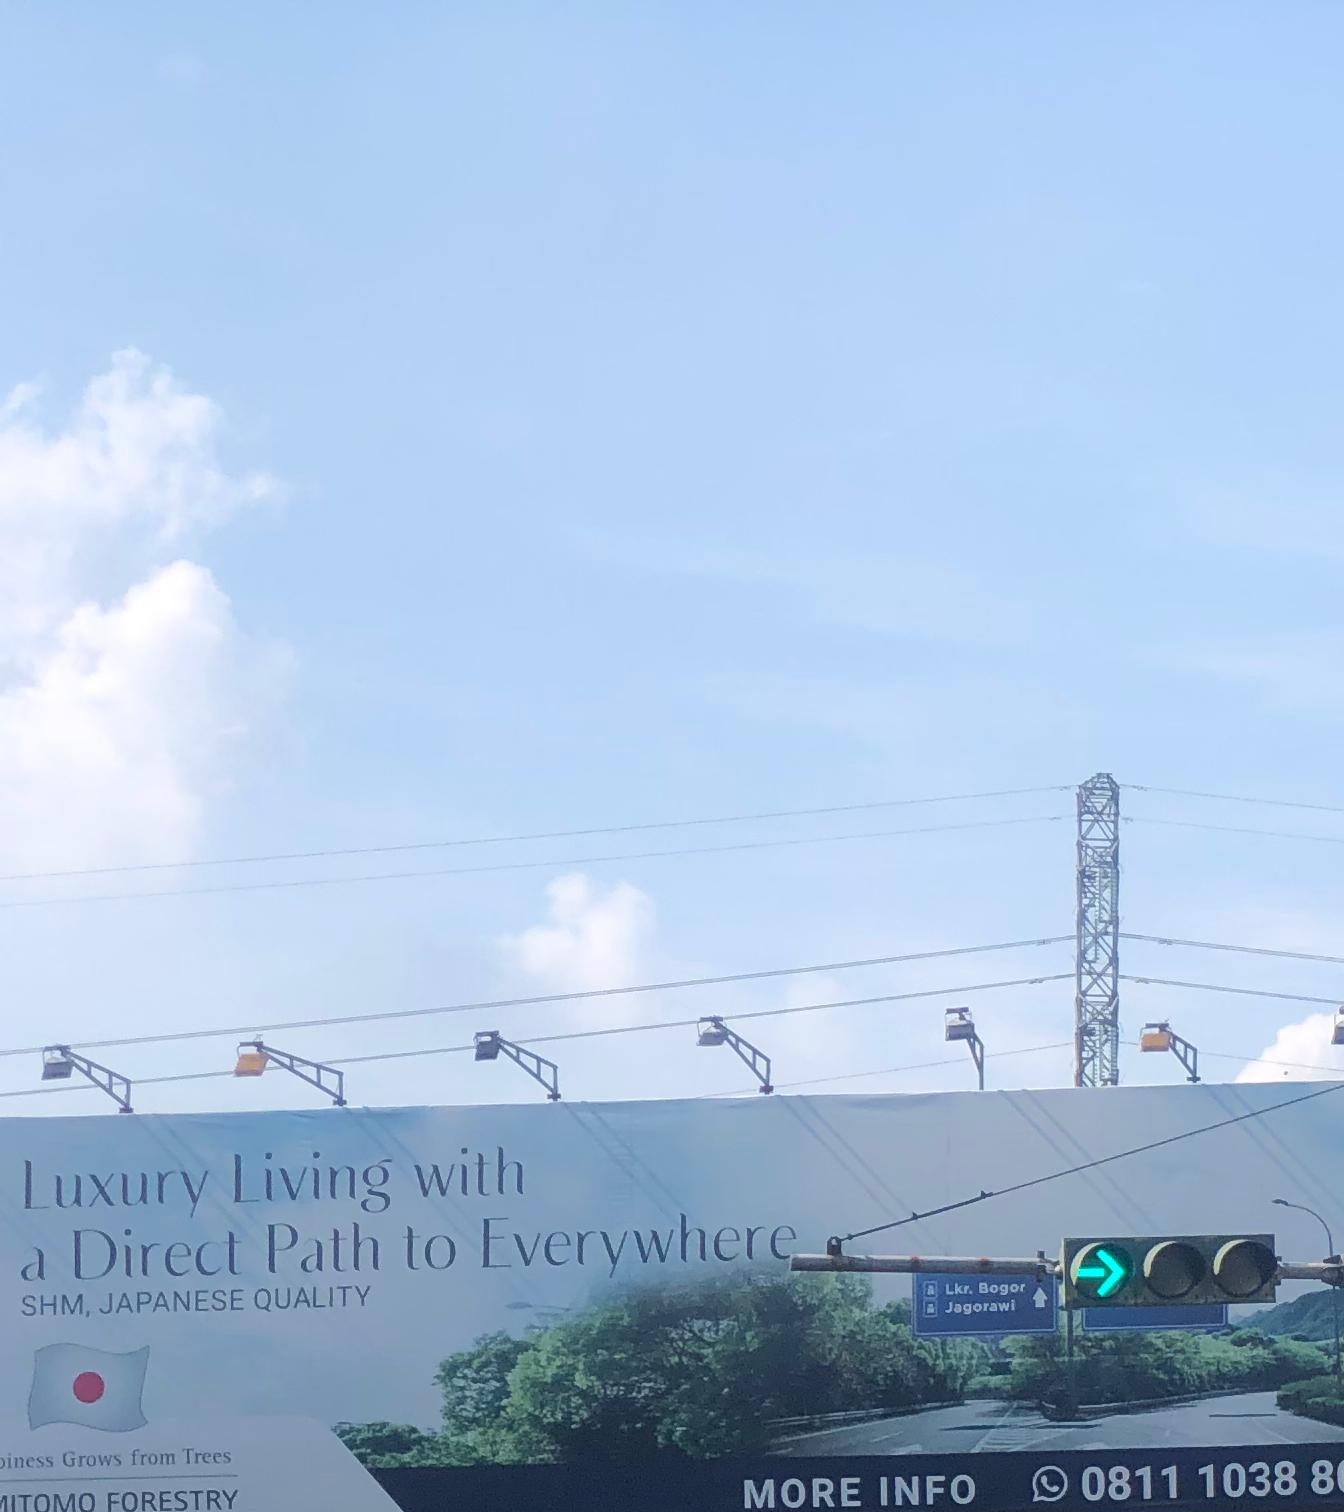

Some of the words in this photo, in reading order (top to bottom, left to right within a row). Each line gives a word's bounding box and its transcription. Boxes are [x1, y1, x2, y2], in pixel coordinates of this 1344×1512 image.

[23, 1158, 209, 1217] Luxury
[233, 1151, 392, 1213] Living
[415, 1147, 525, 1197] with
[20, 1244, 46, 1281] a
[73, 1225, 240, 1279] Direct
[266, 1221, 381, 1273] Path
[406, 1227, 456, 1272] to
[481, 1212, 798, 1276] Everywhere
[21, 1293, 92, 1320] SHM,
[98, 1287, 245, 1315] JAPANESE
[253, 1284, 371, 1310] QUALITY
[945, 1283, 973, 1295] Lkr.
[978, 1282, 1026, 1296] Bogor
[945, 1300, 1015, 1315] Jagorawi
[62, 1451, 122, 1467] Grows
[131, 1449, 175, 1466] from
[182, 1448, 232, 1465] Trees
[744, 1477, 860, 1510] MORE
[880, 1474, 976, 1507] INFO
[1081, 1464, 1180, 1500] 0811
[1198, 1461, 1297, 1498] 1038
[107, 1489, 238, 1512] FORESTRY
